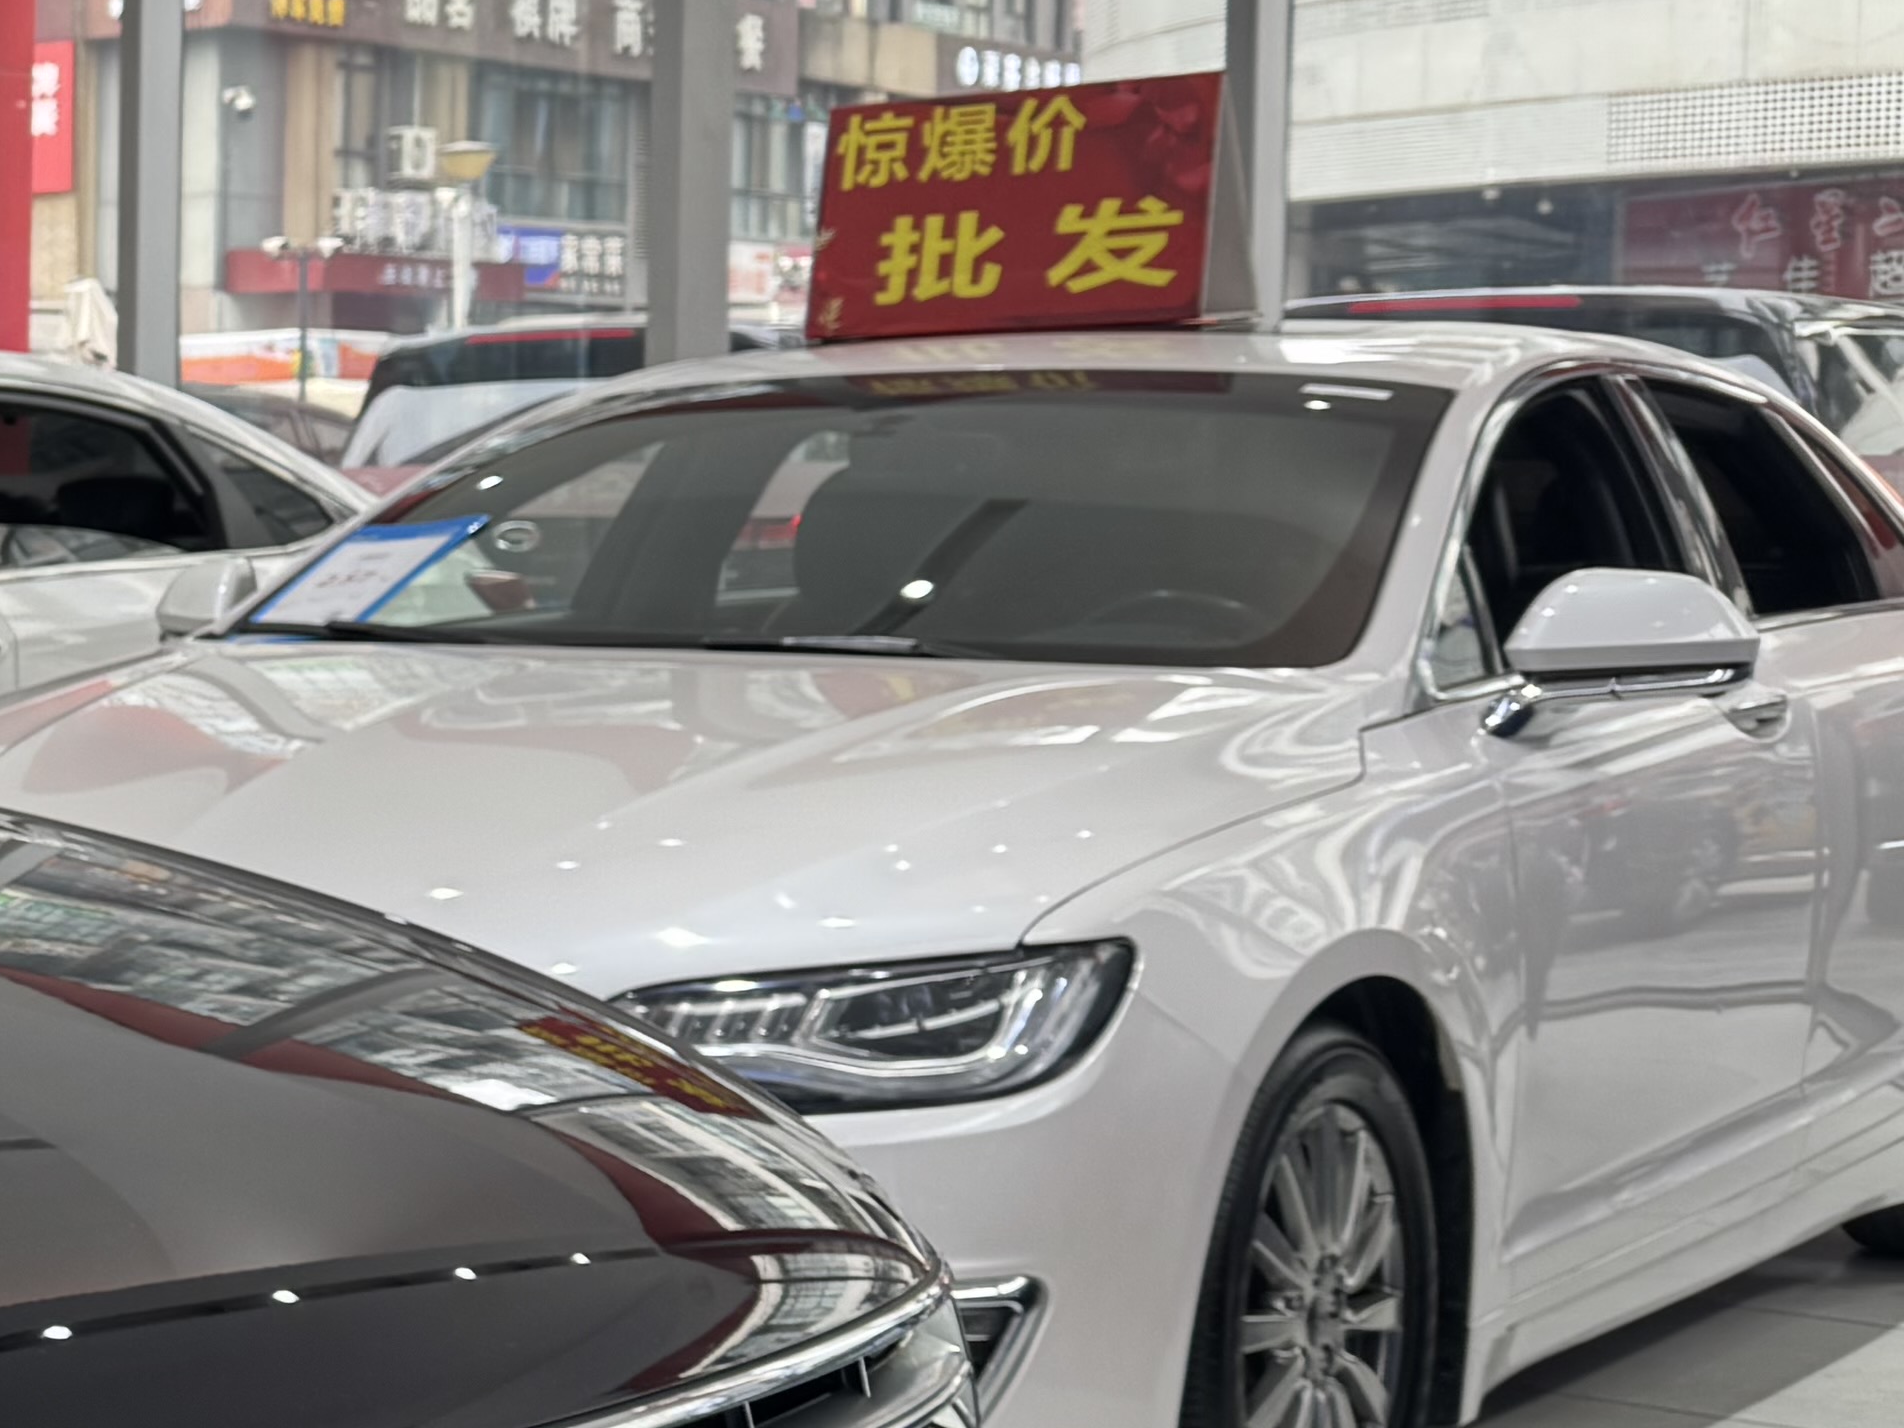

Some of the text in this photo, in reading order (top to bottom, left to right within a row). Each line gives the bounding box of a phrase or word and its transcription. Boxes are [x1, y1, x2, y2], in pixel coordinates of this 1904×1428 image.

[836, 93, 1087, 192] 惊爆价
[872, 194, 1185, 307] 批发
